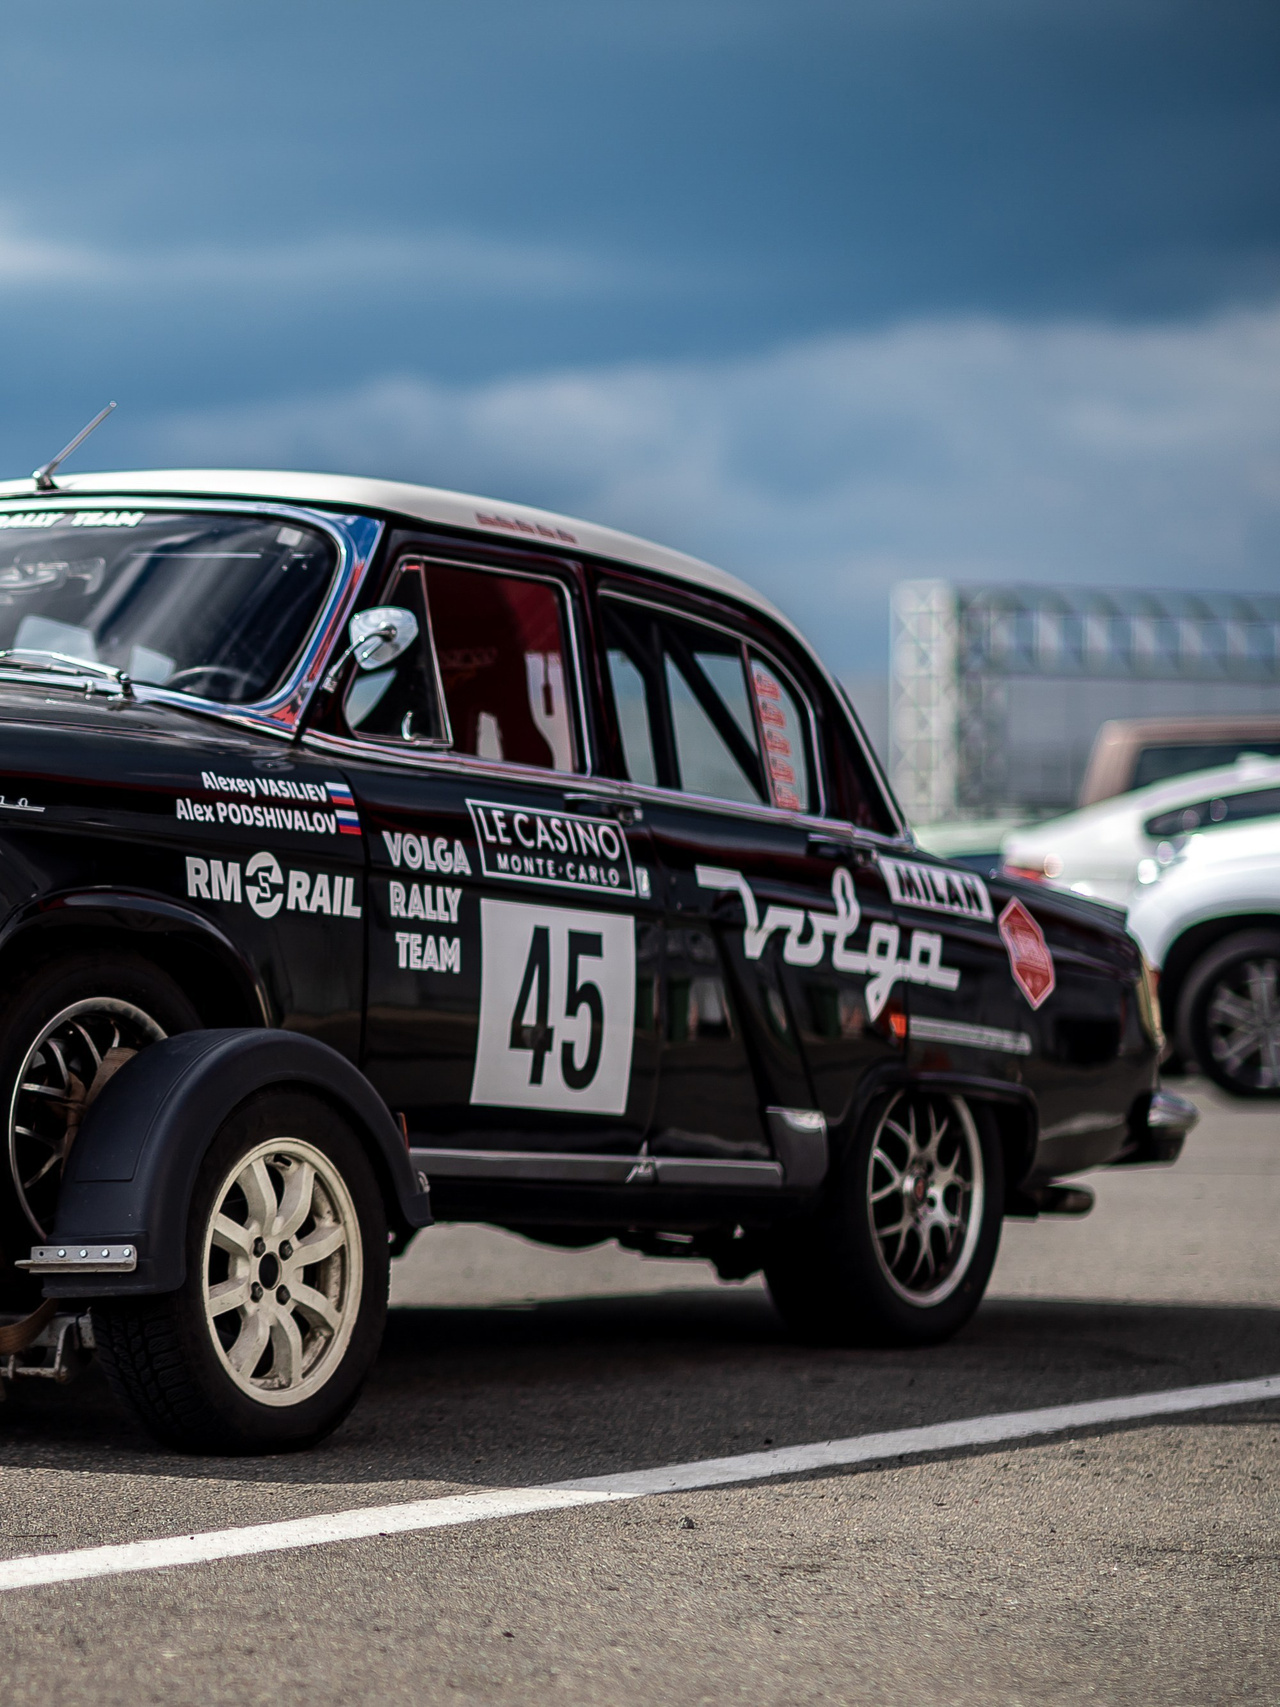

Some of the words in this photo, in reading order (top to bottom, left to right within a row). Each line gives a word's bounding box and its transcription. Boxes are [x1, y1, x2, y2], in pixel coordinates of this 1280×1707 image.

[70, 511, 146, 528] TEAM
[201, 771, 256, 798] Alexey
[255, 777, 327, 803] VASILIEV
[175, 797, 215, 823] Alex
[215, 801, 337, 835] PODSHIVALOV
[477, 807, 512, 845] LE
[513, 812, 621, 861] CASINO
[381, 830, 473, 876] VOLGA
[286, 869, 363, 919] RAIL
[389, 880, 463, 924] RALLY
[395, 931, 461, 974] TEAM
[695, 864, 961, 1023] Volga
[507, 924, 604, 1091] 45
